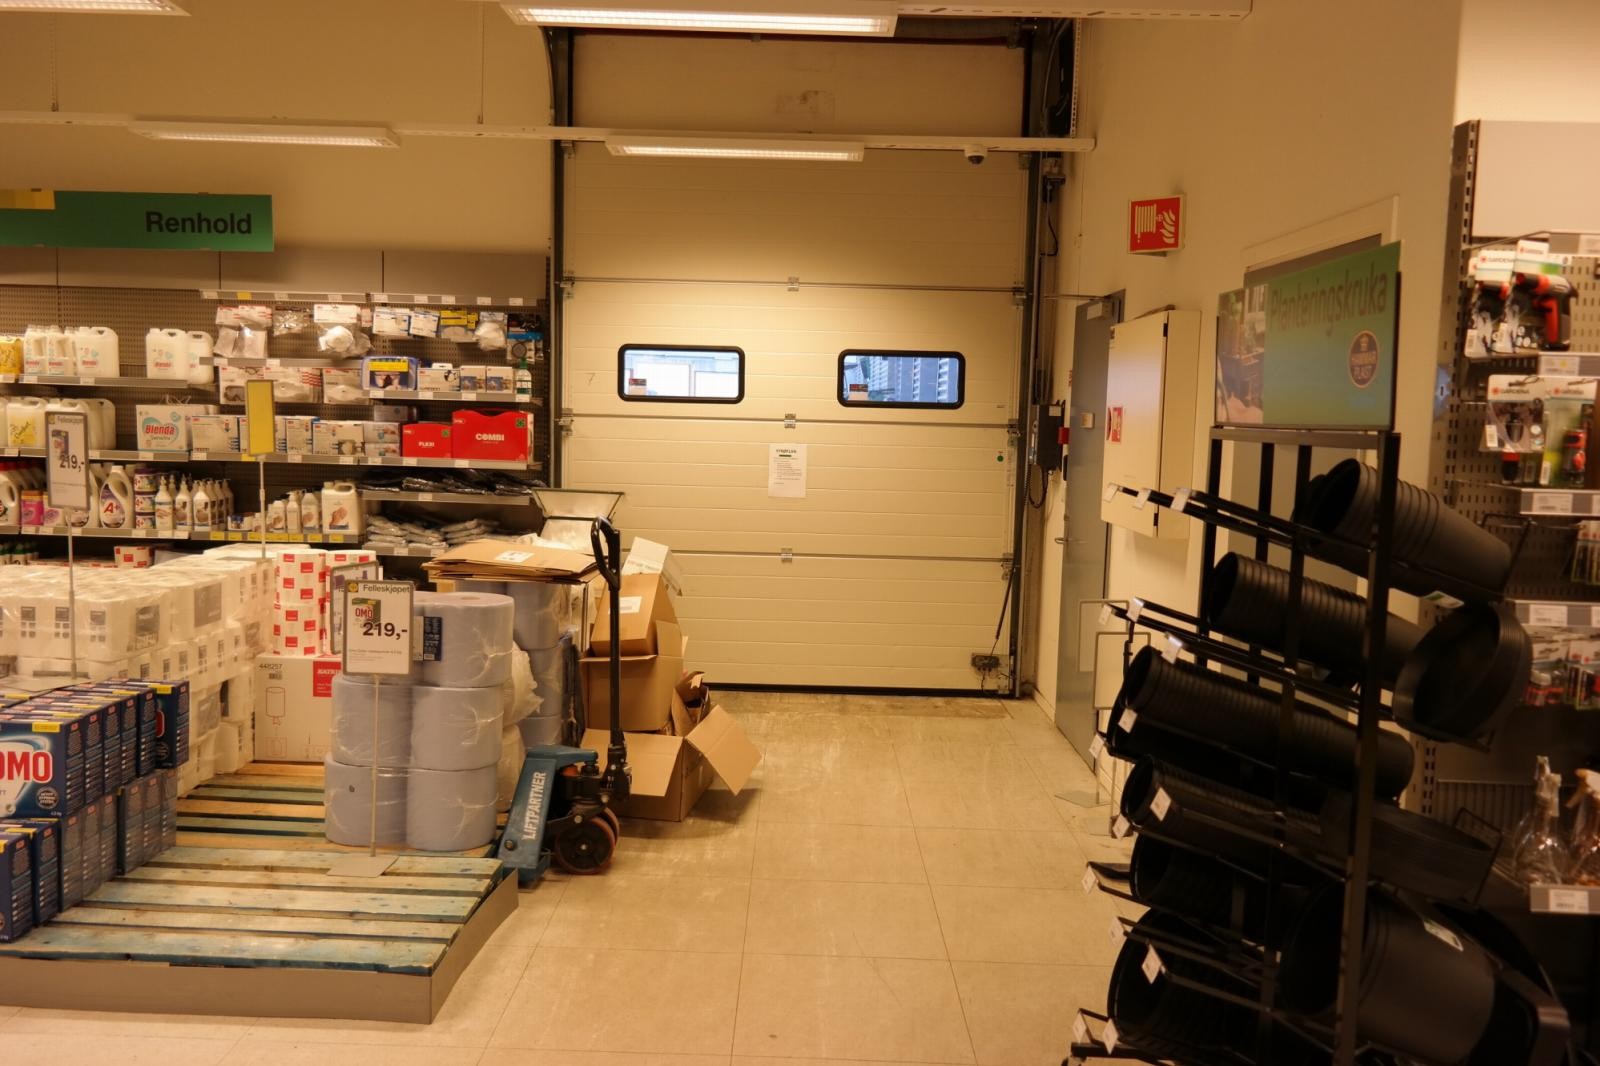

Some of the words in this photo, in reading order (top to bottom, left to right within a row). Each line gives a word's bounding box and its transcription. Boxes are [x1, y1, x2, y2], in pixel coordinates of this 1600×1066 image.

[145, 211, 252, 234] Renhold
[1270, 261, 1389, 338] Planteringskruka
[145, 424, 176, 436] Blenda
[475, 433, 505, 442] COMBI
[59, 454, 86, 473] 219,-
[103, 501, 121, 514] A+
[362, 583, 411, 595] Felleskjøpet
[354, 606, 374, 619] OMO
[362, 622, 408, 641] 219,-
[0, 750, 53, 782] MO
[521, 771, 547, 841] LIFTPARTNER
